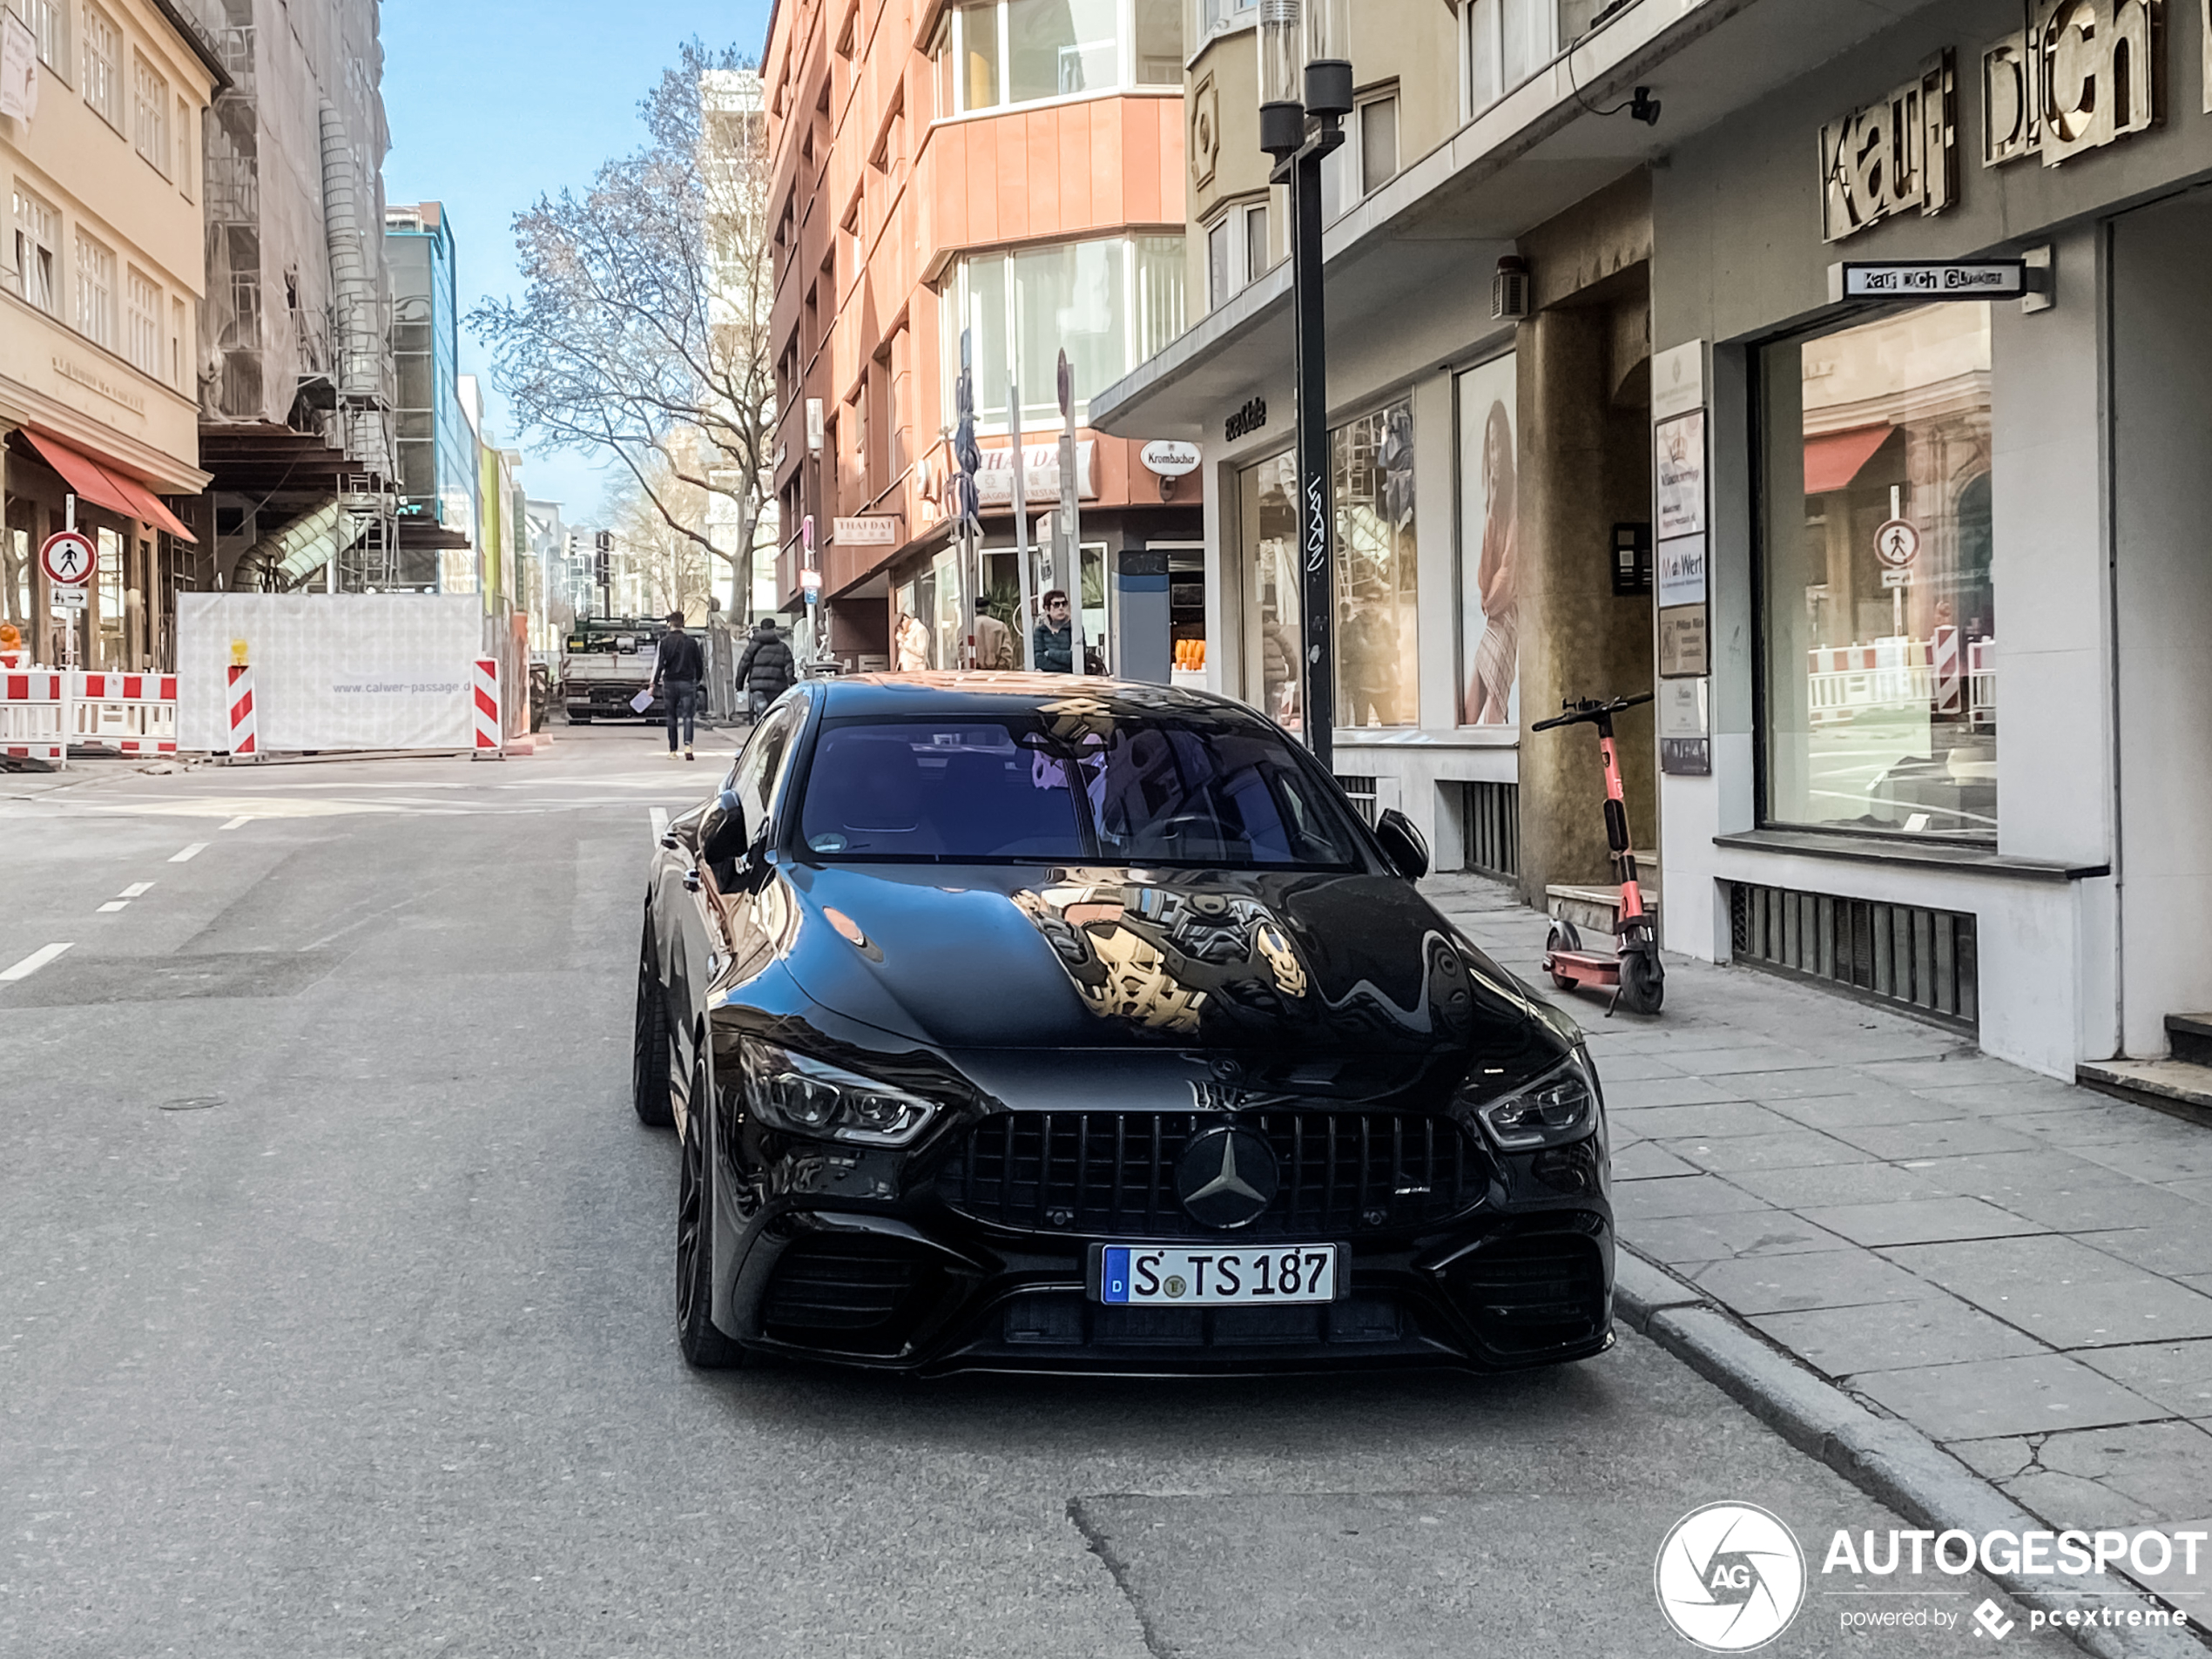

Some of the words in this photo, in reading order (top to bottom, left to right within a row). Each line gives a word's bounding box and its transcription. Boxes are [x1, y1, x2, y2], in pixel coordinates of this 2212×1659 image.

[1818, 45, 1956, 244] Kauf
[1149, 453, 1196, 464] Krombacher
[839, 521, 867, 529] THAI
[870, 521, 891, 529] DAT
[333, 681, 471, 694] www.calwer-passage.d
[1112, 1280, 1123, 1292] D
